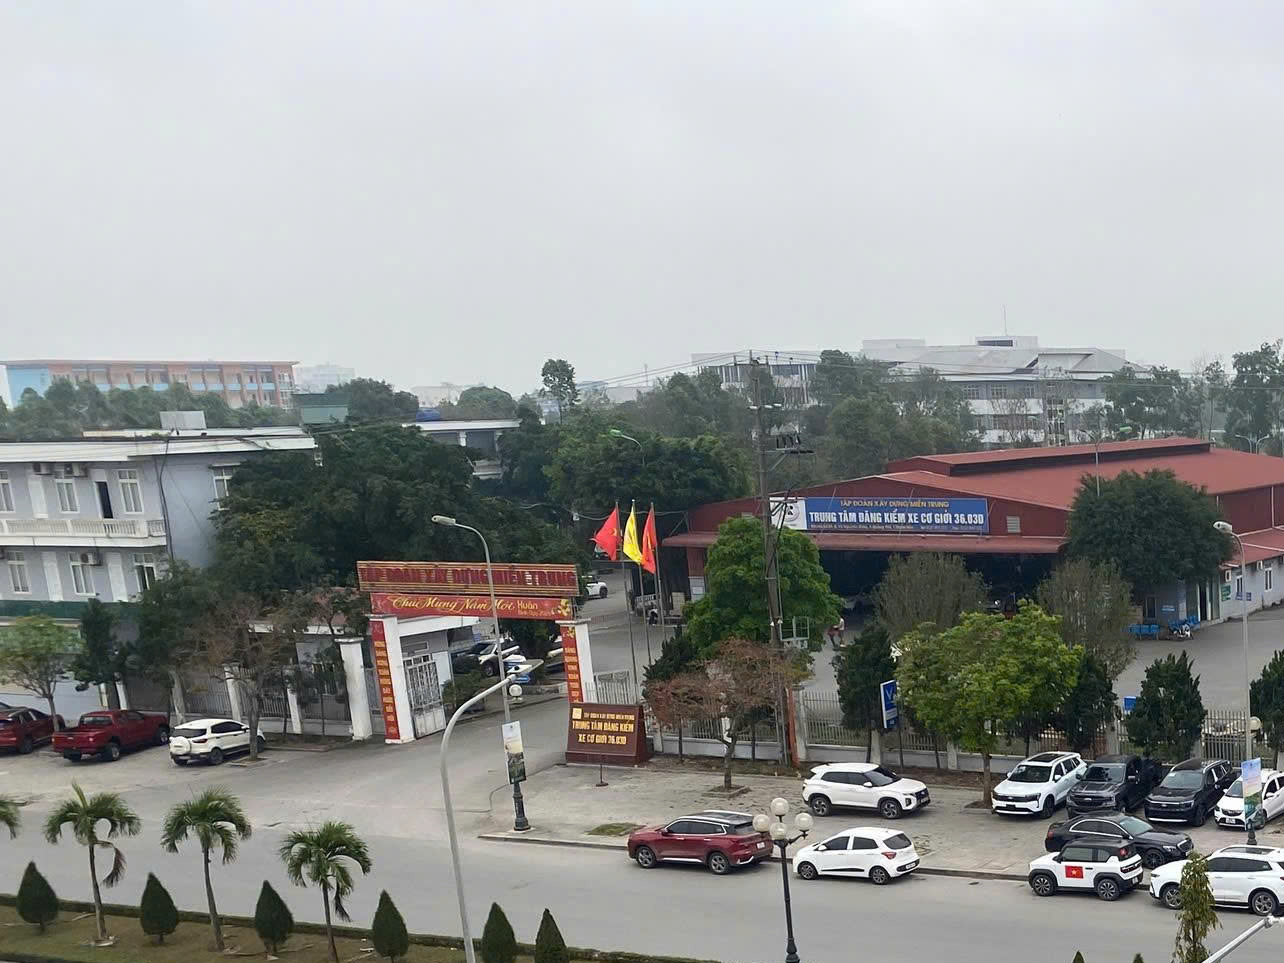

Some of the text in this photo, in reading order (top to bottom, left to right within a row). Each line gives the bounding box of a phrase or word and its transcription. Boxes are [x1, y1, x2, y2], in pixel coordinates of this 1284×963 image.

[809, 511, 837, 523] TRUNG
[839, 510, 857, 523] TÂM
[907, 513, 919, 524] XE
[921, 512, 933, 524] CƠ
[572, 721, 590, 730] TRUNG
[578, 734, 586, 743] XE
